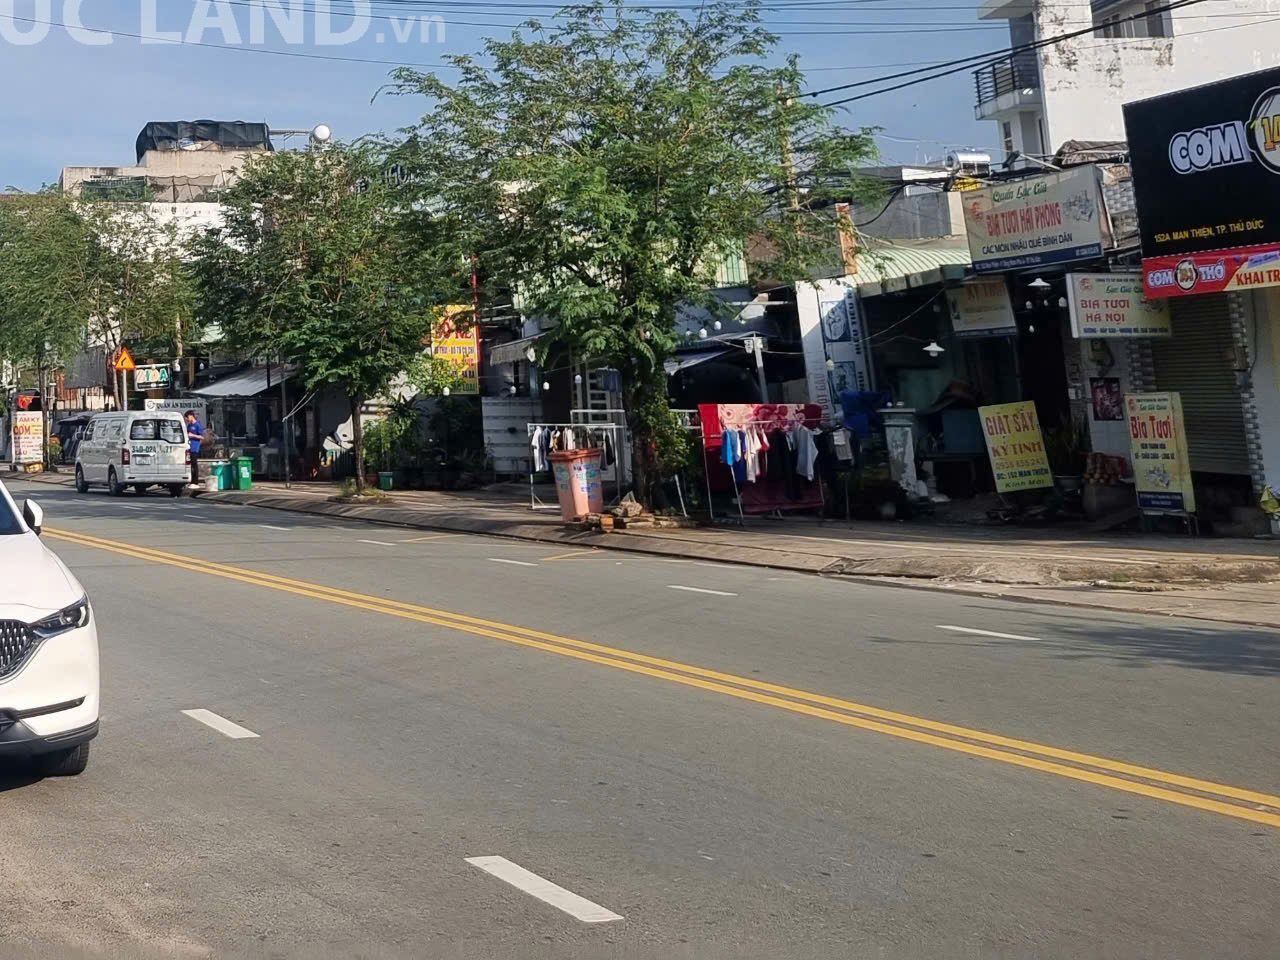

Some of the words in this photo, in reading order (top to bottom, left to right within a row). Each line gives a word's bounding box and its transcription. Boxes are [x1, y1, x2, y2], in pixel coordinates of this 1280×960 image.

[987, 214, 1000, 236] BIA
[1001, 209, 1020, 234] TƯƠI
[1020, 202, 1035, 233] HẢI
[1035, 200, 1062, 230] PHÒNG
[1172, 230, 1189, 240] MAN
[1229, 219, 1244, 232] THỦ
[1246, 218, 1264, 231] ĐỨC
[1236, 270, 1265, 286] KHAI
[1081, 300, 1100, 309] BIA
[1105, 298, 1130, 309] TƯƠI
[1105, 312, 1125, 325] NỘI
[1130, 416, 1148, 438] Bia
[1149, 416, 1172, 439] Tươi
